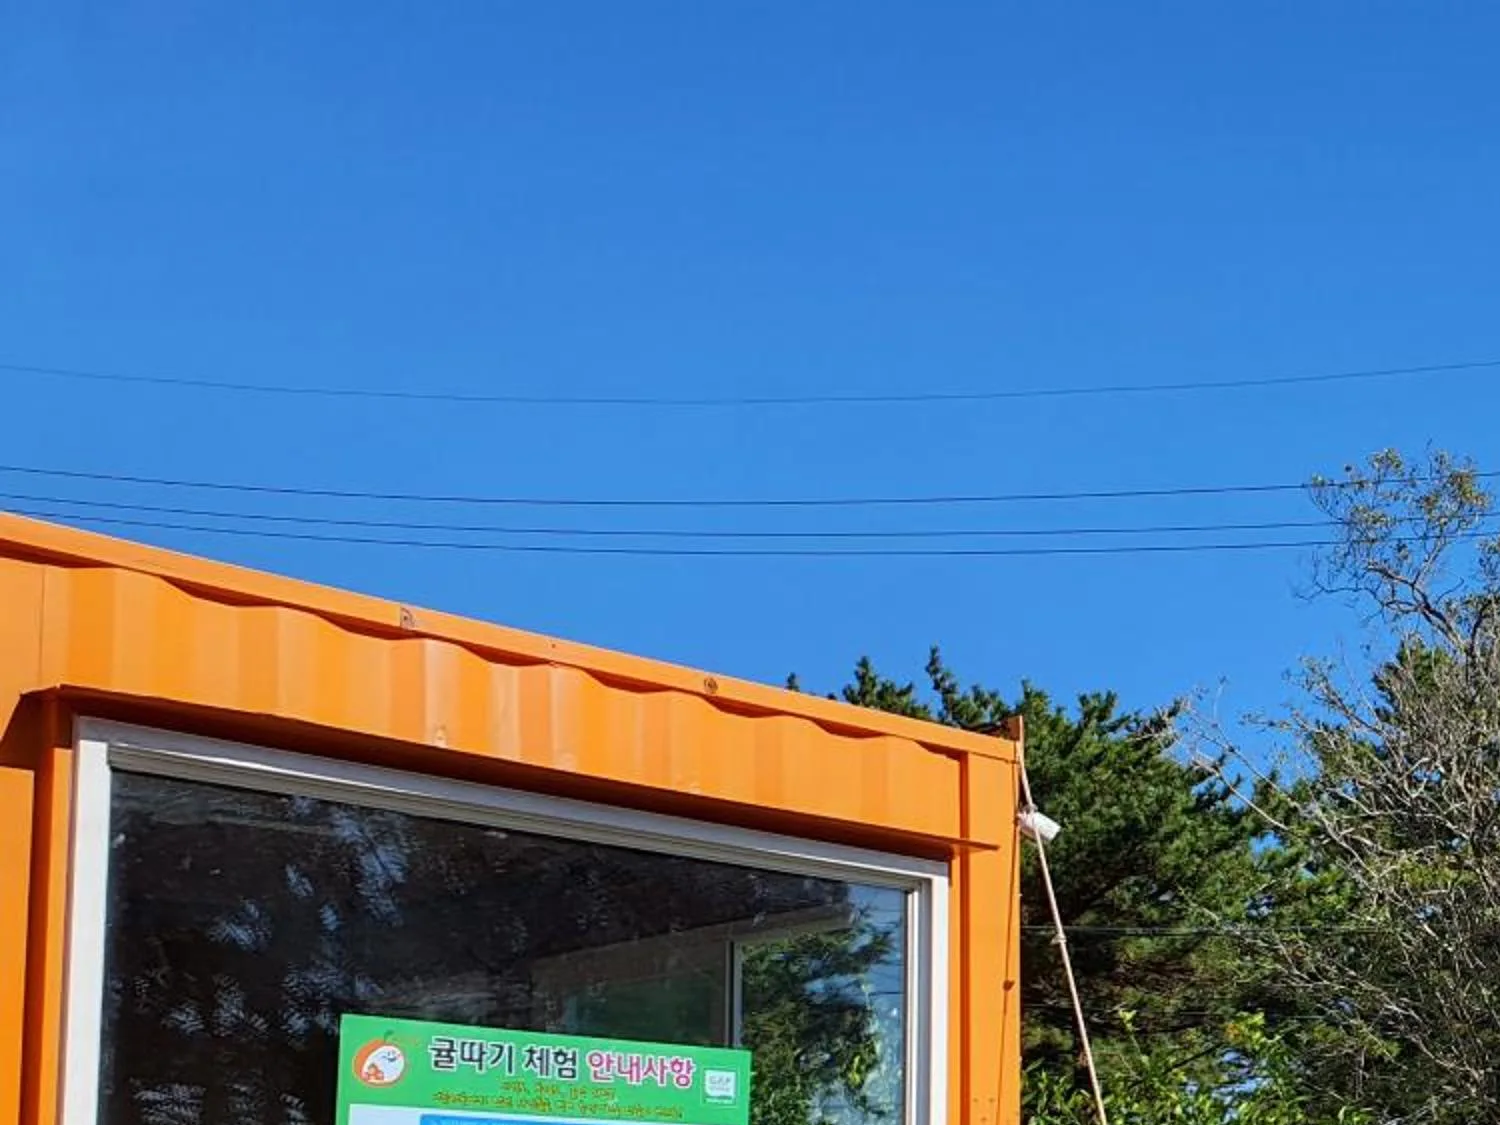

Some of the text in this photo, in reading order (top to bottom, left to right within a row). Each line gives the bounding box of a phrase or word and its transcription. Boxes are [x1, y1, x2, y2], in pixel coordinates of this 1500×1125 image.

[431, 1037, 694, 1087] 귤따기 체험 안내사항
